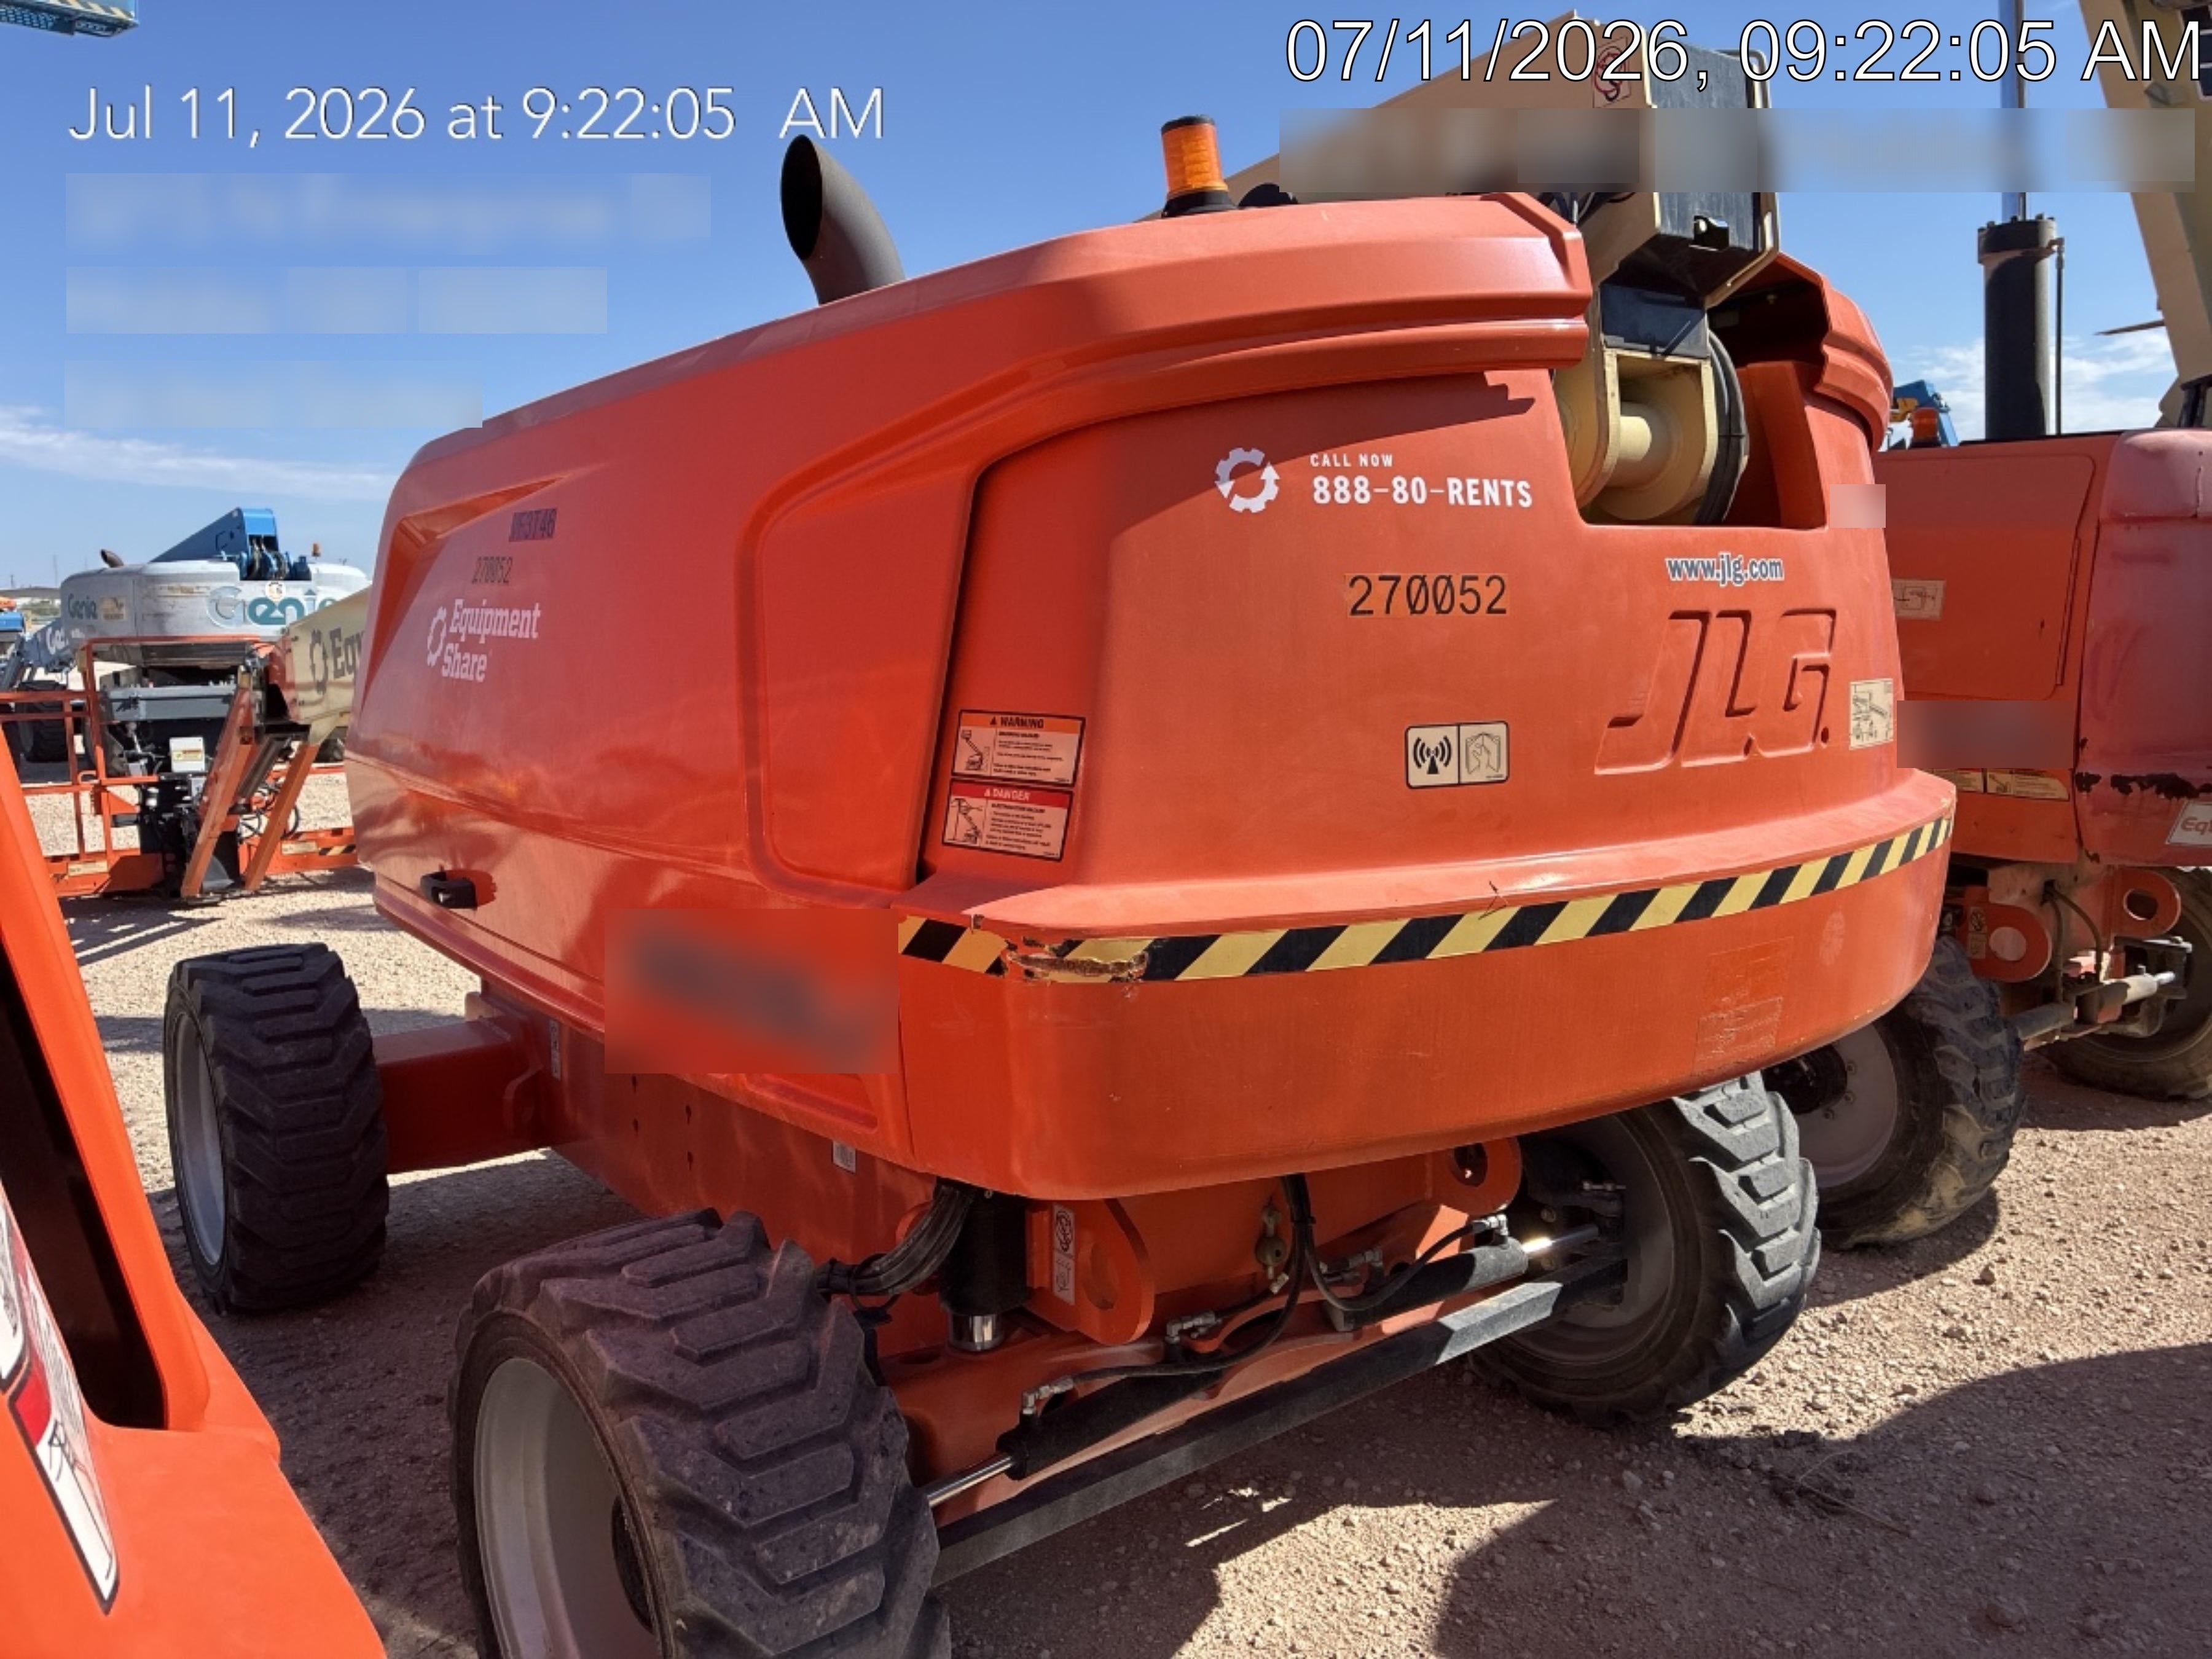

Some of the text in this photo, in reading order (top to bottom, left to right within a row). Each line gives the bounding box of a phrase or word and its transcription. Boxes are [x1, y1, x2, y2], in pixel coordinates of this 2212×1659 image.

[1310, 453, 1394, 468] CALL NOW
[1312, 475, 1532, 508] 888-80-RENTS
[1666, 551, 1784, 586] www.jlg.com
[1348, 574, 1507, 616] 270052
[449, 598, 541, 645] Equipment
[441, 643, 487, 683] Share
[2181, 817, 2212, 836] Eq
